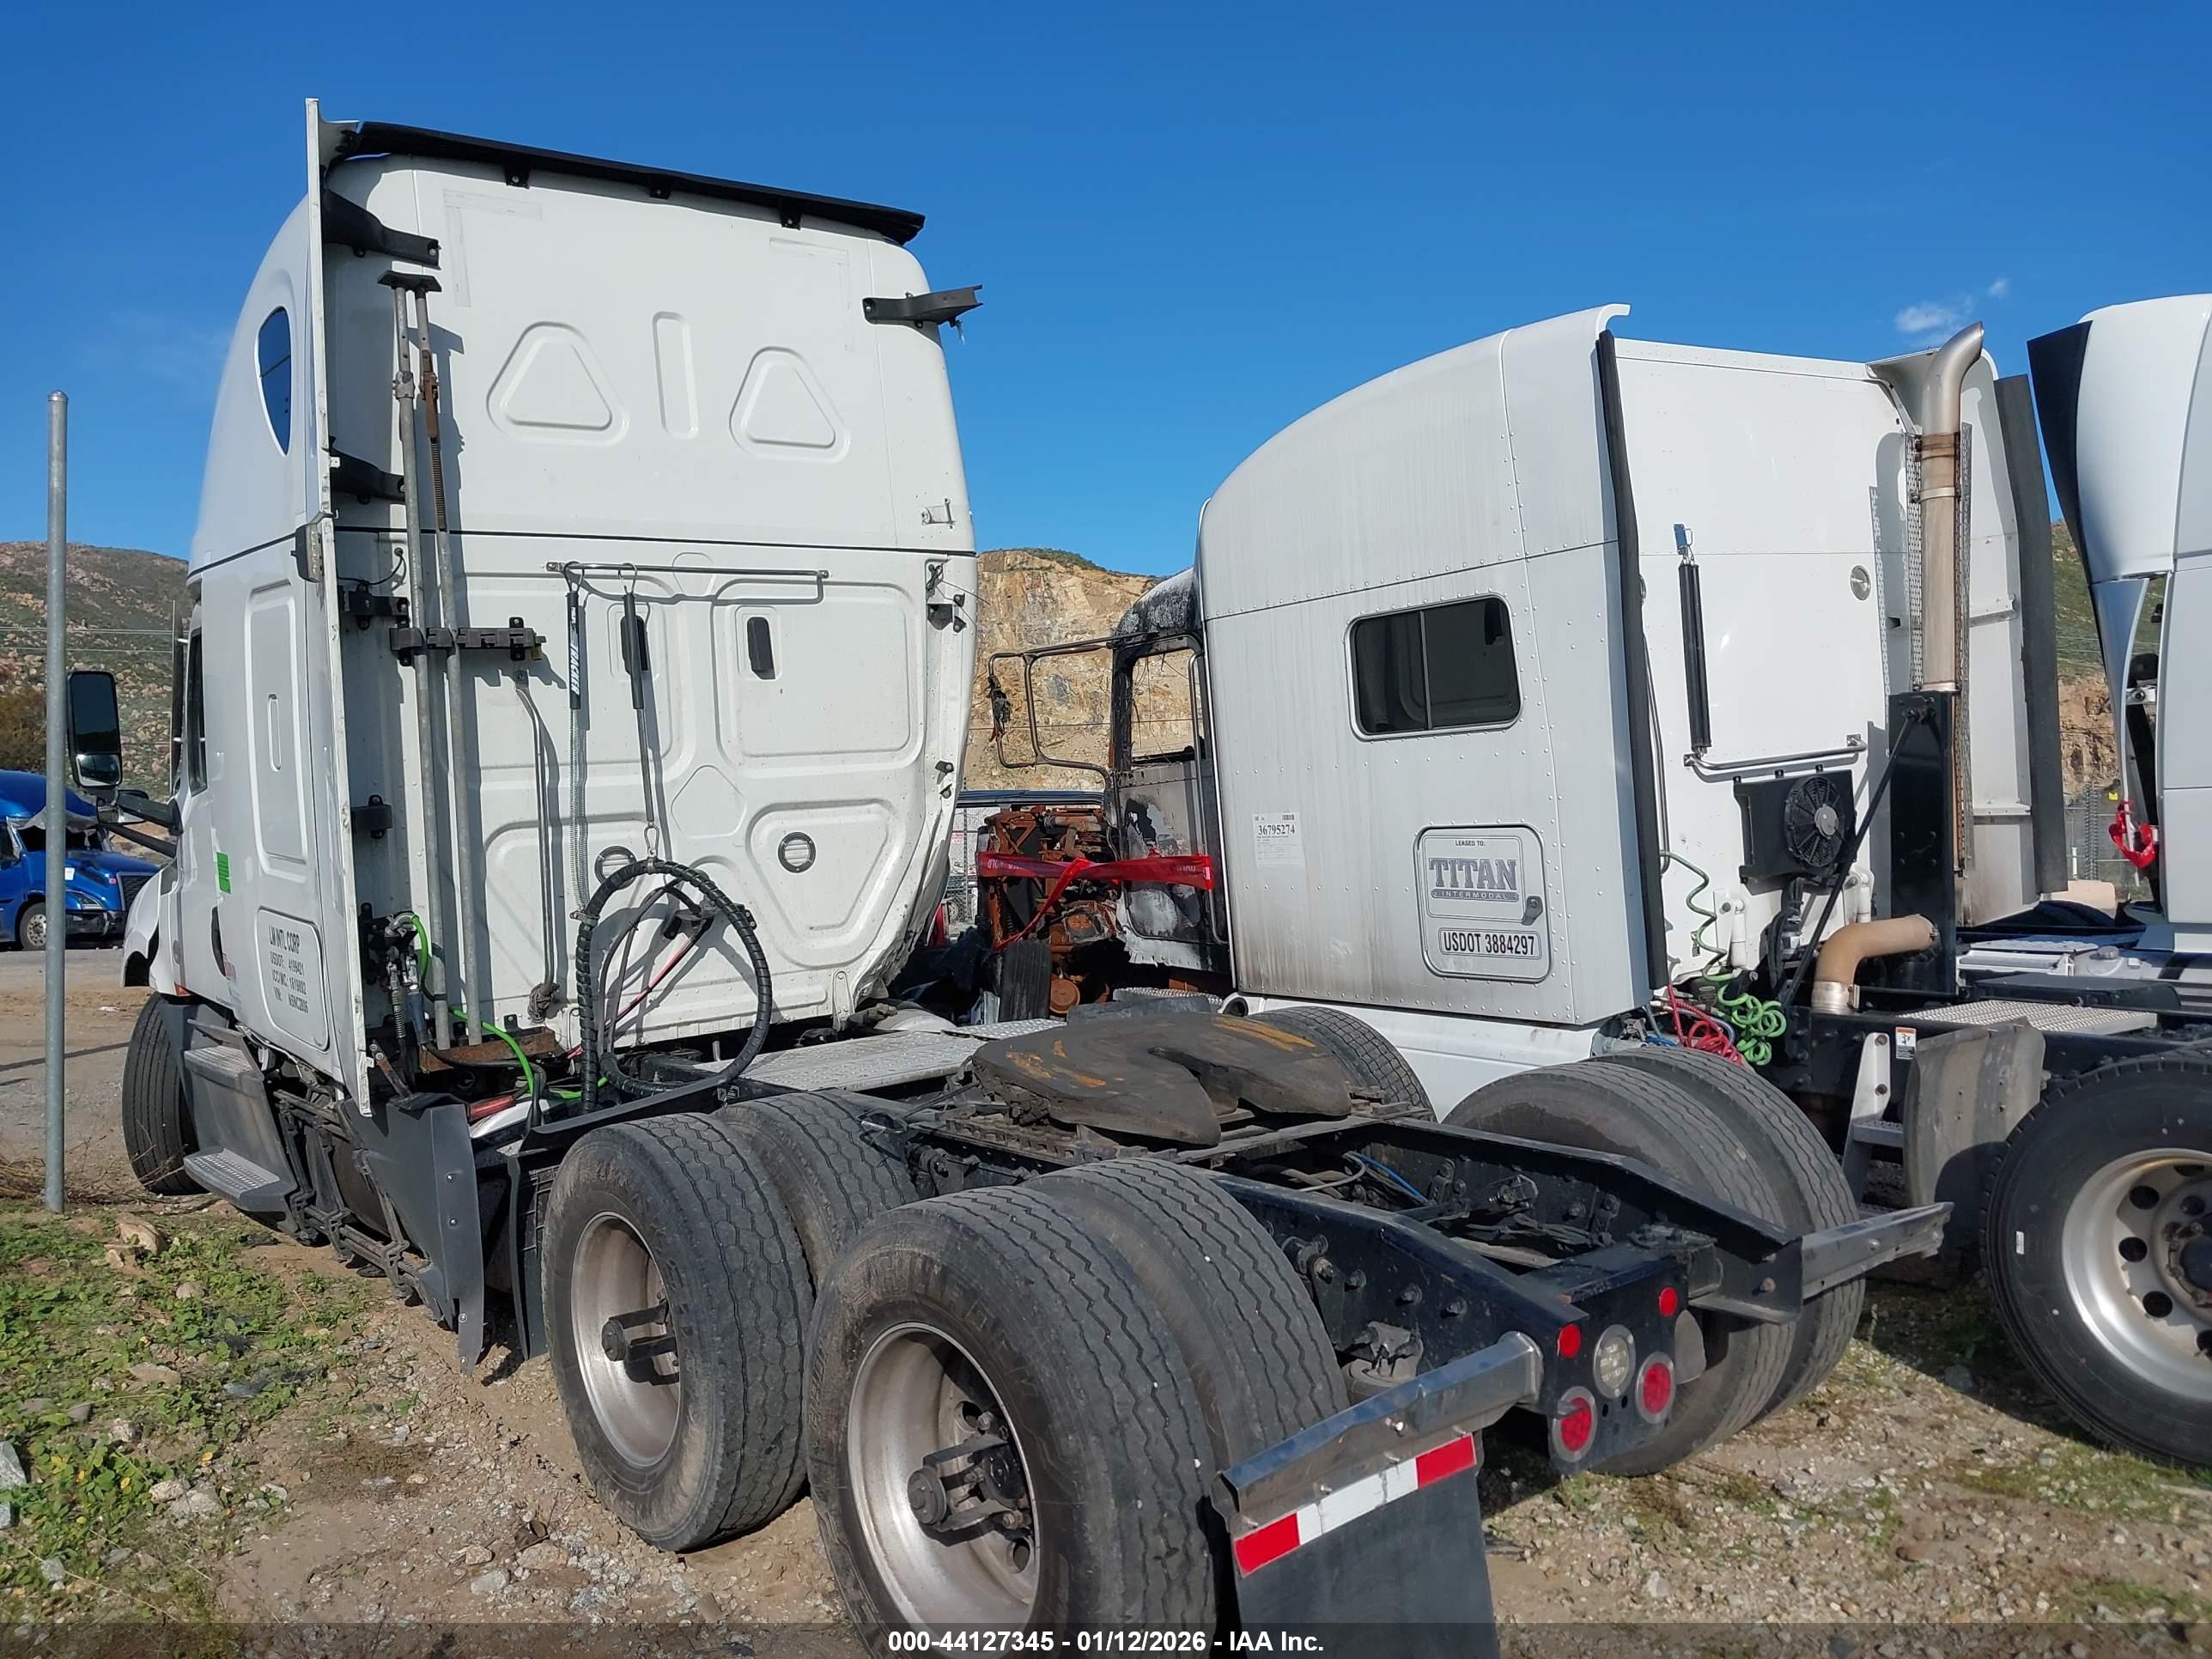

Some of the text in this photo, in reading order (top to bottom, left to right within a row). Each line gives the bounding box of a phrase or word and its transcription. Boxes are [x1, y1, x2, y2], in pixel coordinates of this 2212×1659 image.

[569, 643, 580, 696] TRACKER
[1257, 824, 1296, 836] 36795274
[1429, 858, 1517, 890] TITAN
[287, 931, 301, 955] CORP
[1443, 932, 1535, 956] USDOT 3884297
